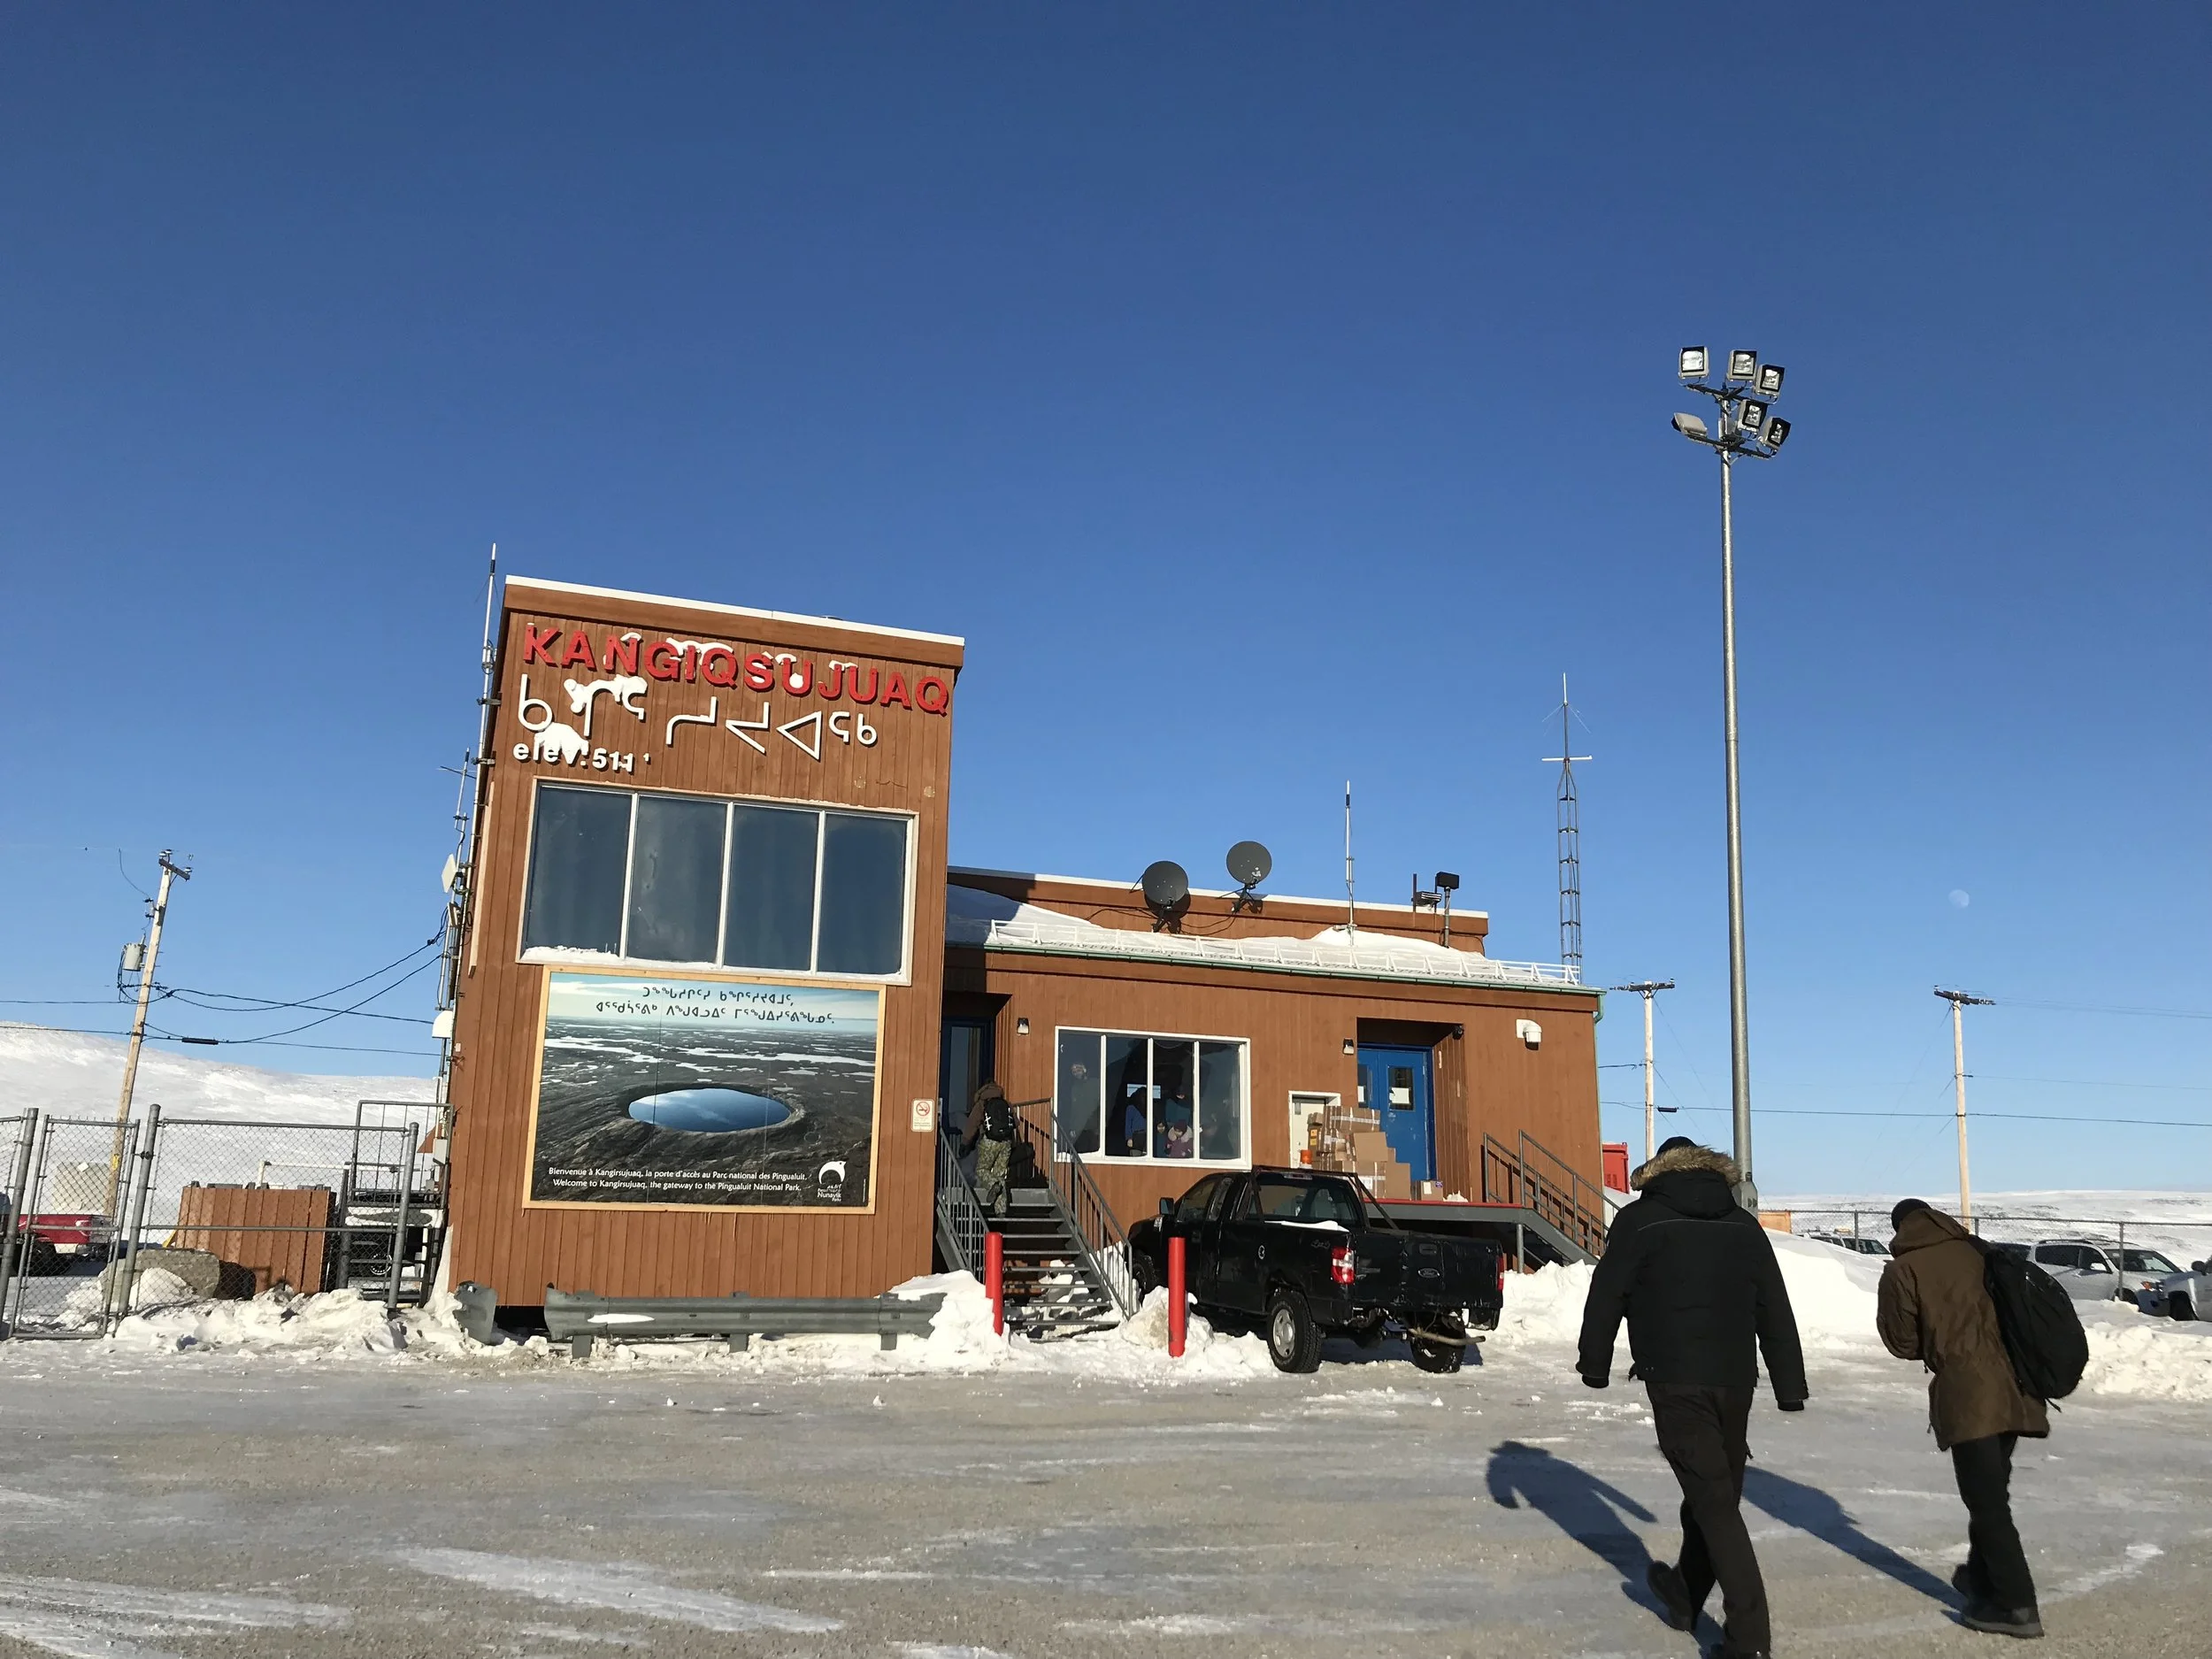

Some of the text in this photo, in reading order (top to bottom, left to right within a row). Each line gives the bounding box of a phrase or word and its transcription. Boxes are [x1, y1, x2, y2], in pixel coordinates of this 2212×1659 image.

[523, 622, 949, 716] KANGIQSUJUAQ
[549, 1167, 587, 1176] Bienvenue
[675, 1170, 701, 1179] d'accès
[712, 1171, 727, 1179] Parc
[728, 1171, 757, 1180] national
[758, 1171, 771, 1180] des
[552, 1178, 588, 1187] Welcome
[663, 1182, 694, 1191] gateway
[718, 1182, 752, 1192] Pingualuit
[785, 1183, 803, 1192] Park.
